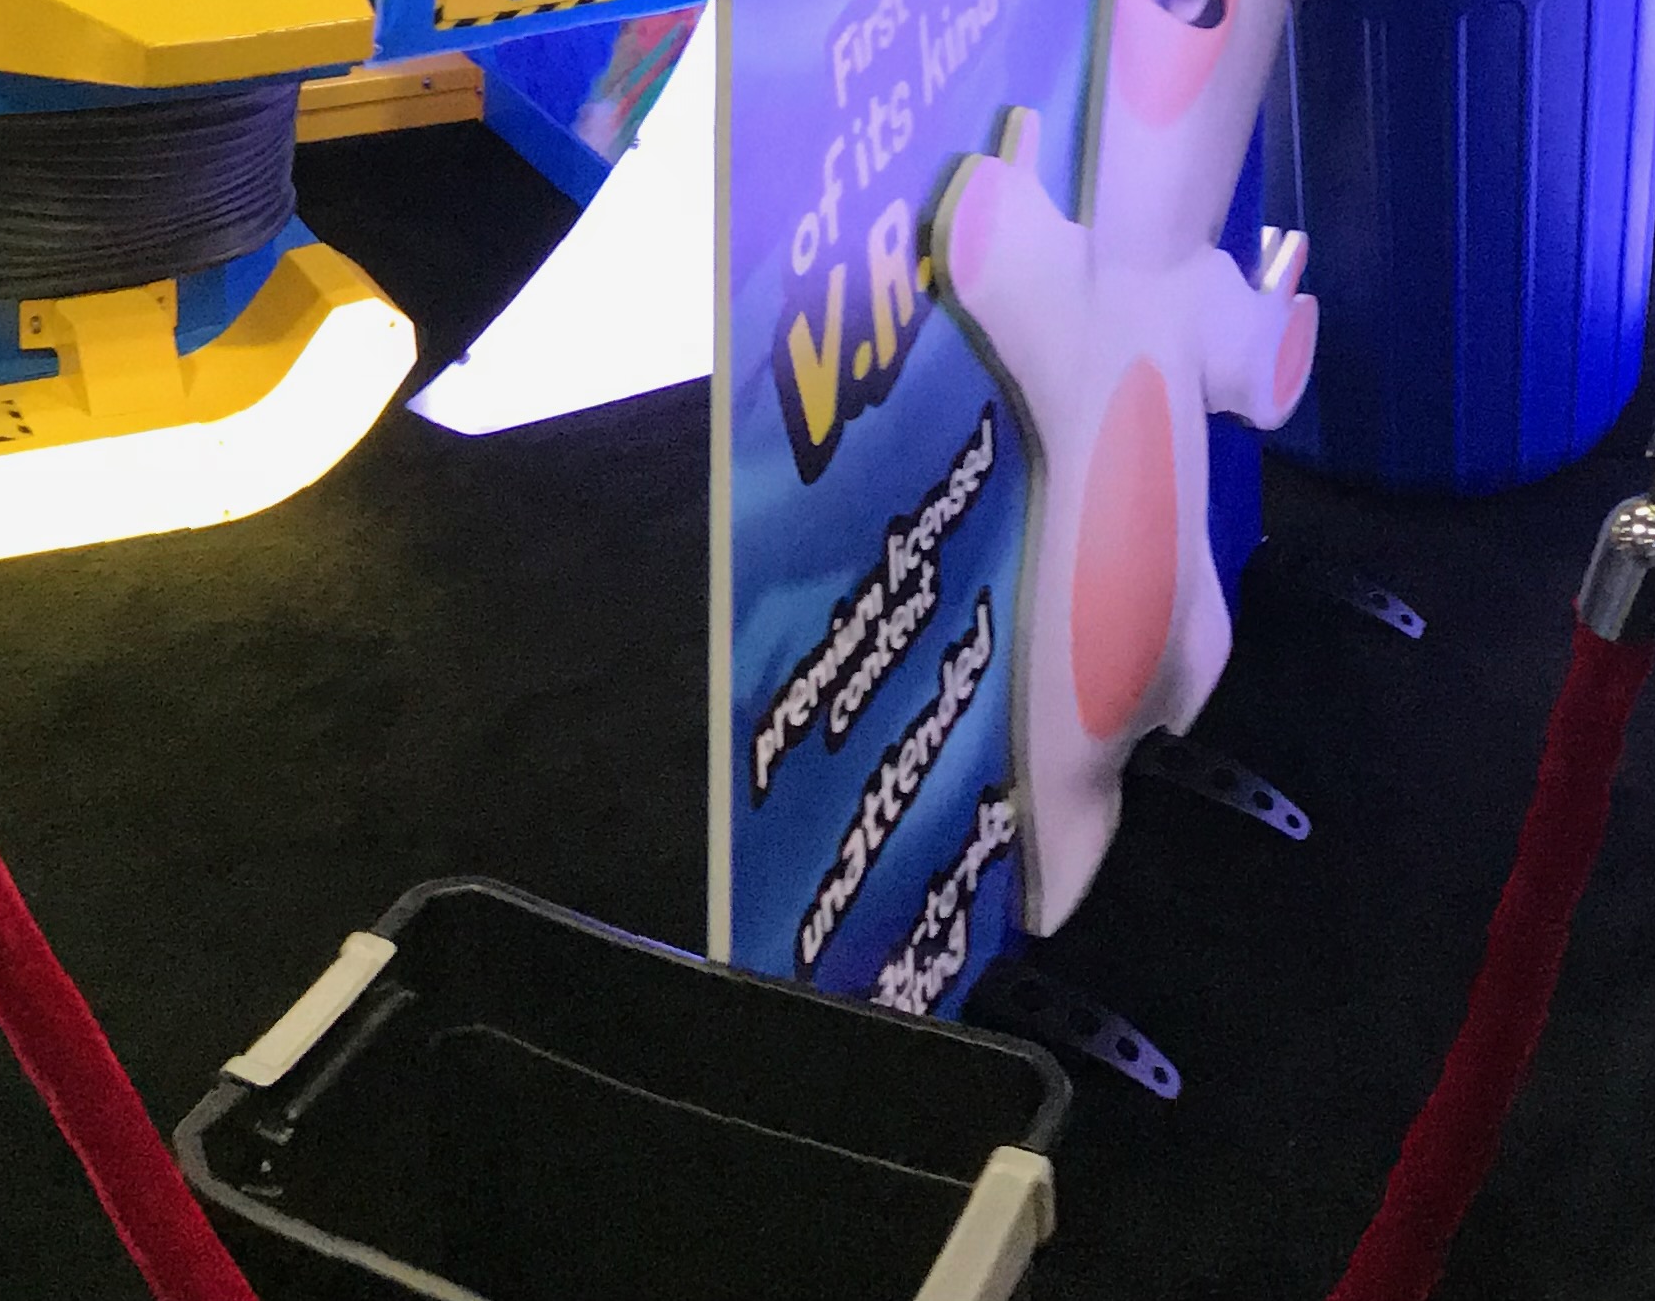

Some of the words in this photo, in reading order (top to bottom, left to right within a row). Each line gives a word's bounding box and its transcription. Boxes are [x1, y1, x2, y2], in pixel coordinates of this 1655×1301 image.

[792, 136, 845, 275] of
[854, 80, 913, 190] its
[756, 582, 884, 792] premium
[888, 417, 993, 594] licensed
[829, 559, 936, 735] content
[802, 603, 992, 964] unattended
